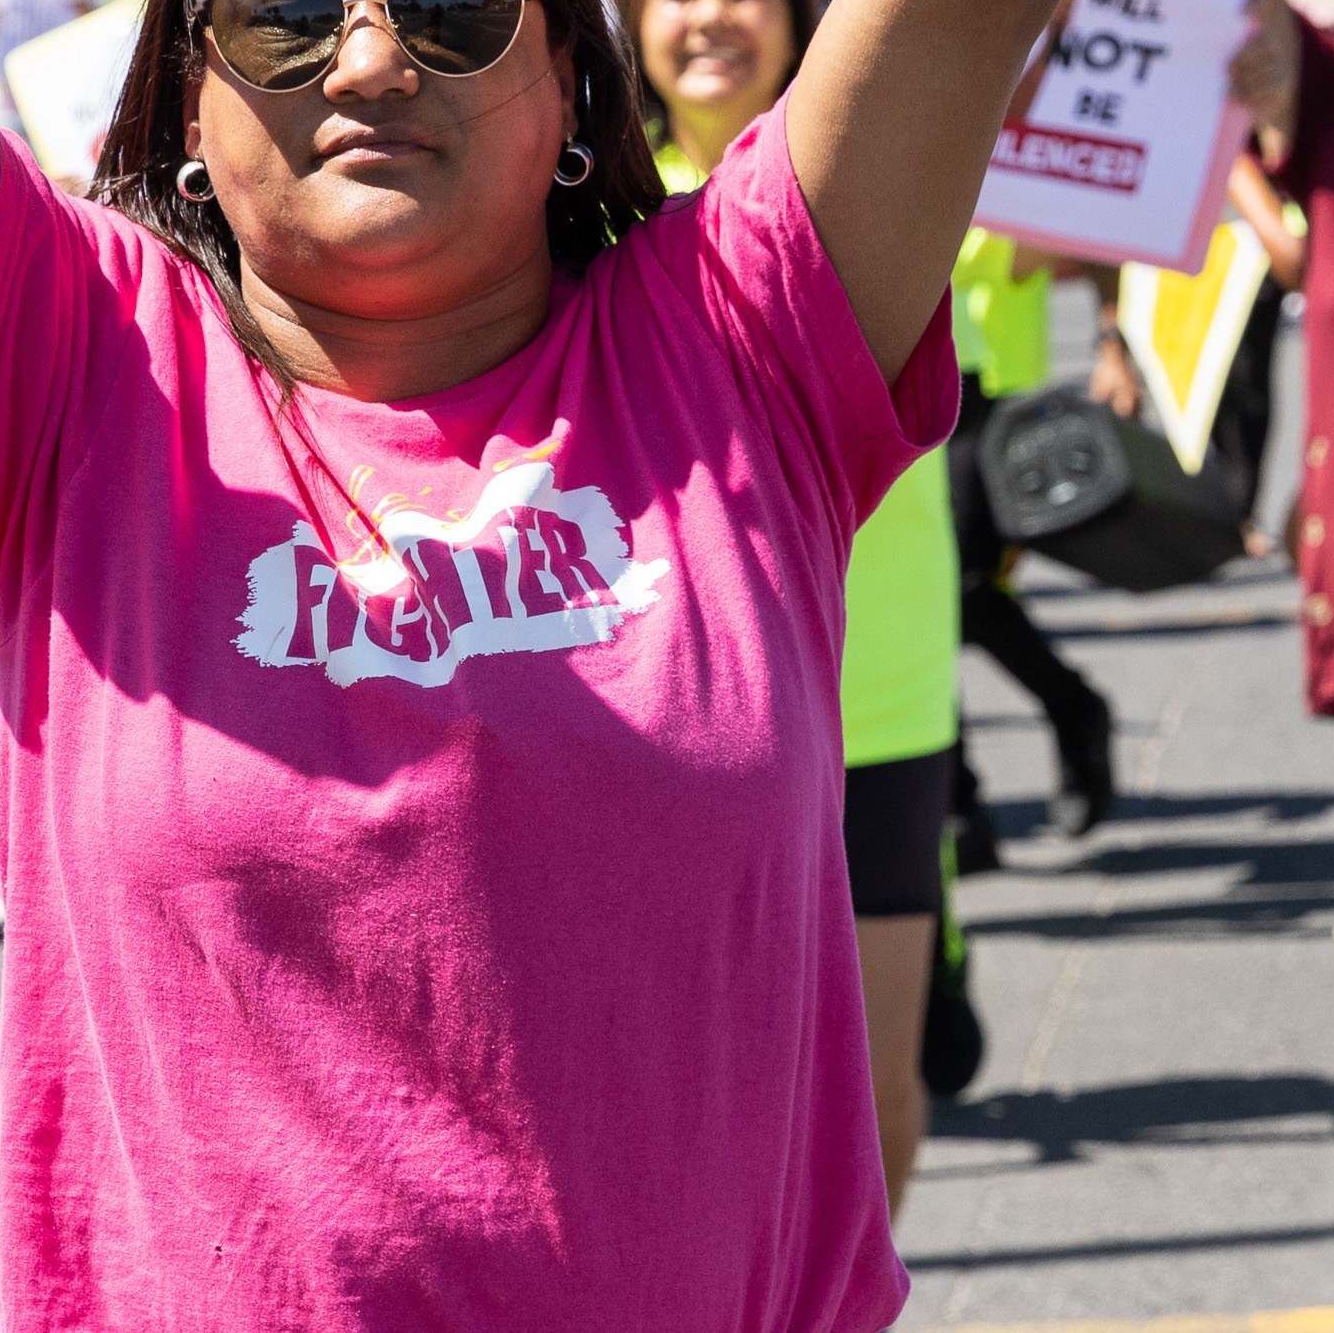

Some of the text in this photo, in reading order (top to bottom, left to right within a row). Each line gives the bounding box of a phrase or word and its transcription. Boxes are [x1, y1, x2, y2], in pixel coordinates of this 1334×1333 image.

[1047, 22, 1169, 84] NOT
[995, 126, 1142, 184] LENCED
[285, 504, 622, 664] FIGHTER
